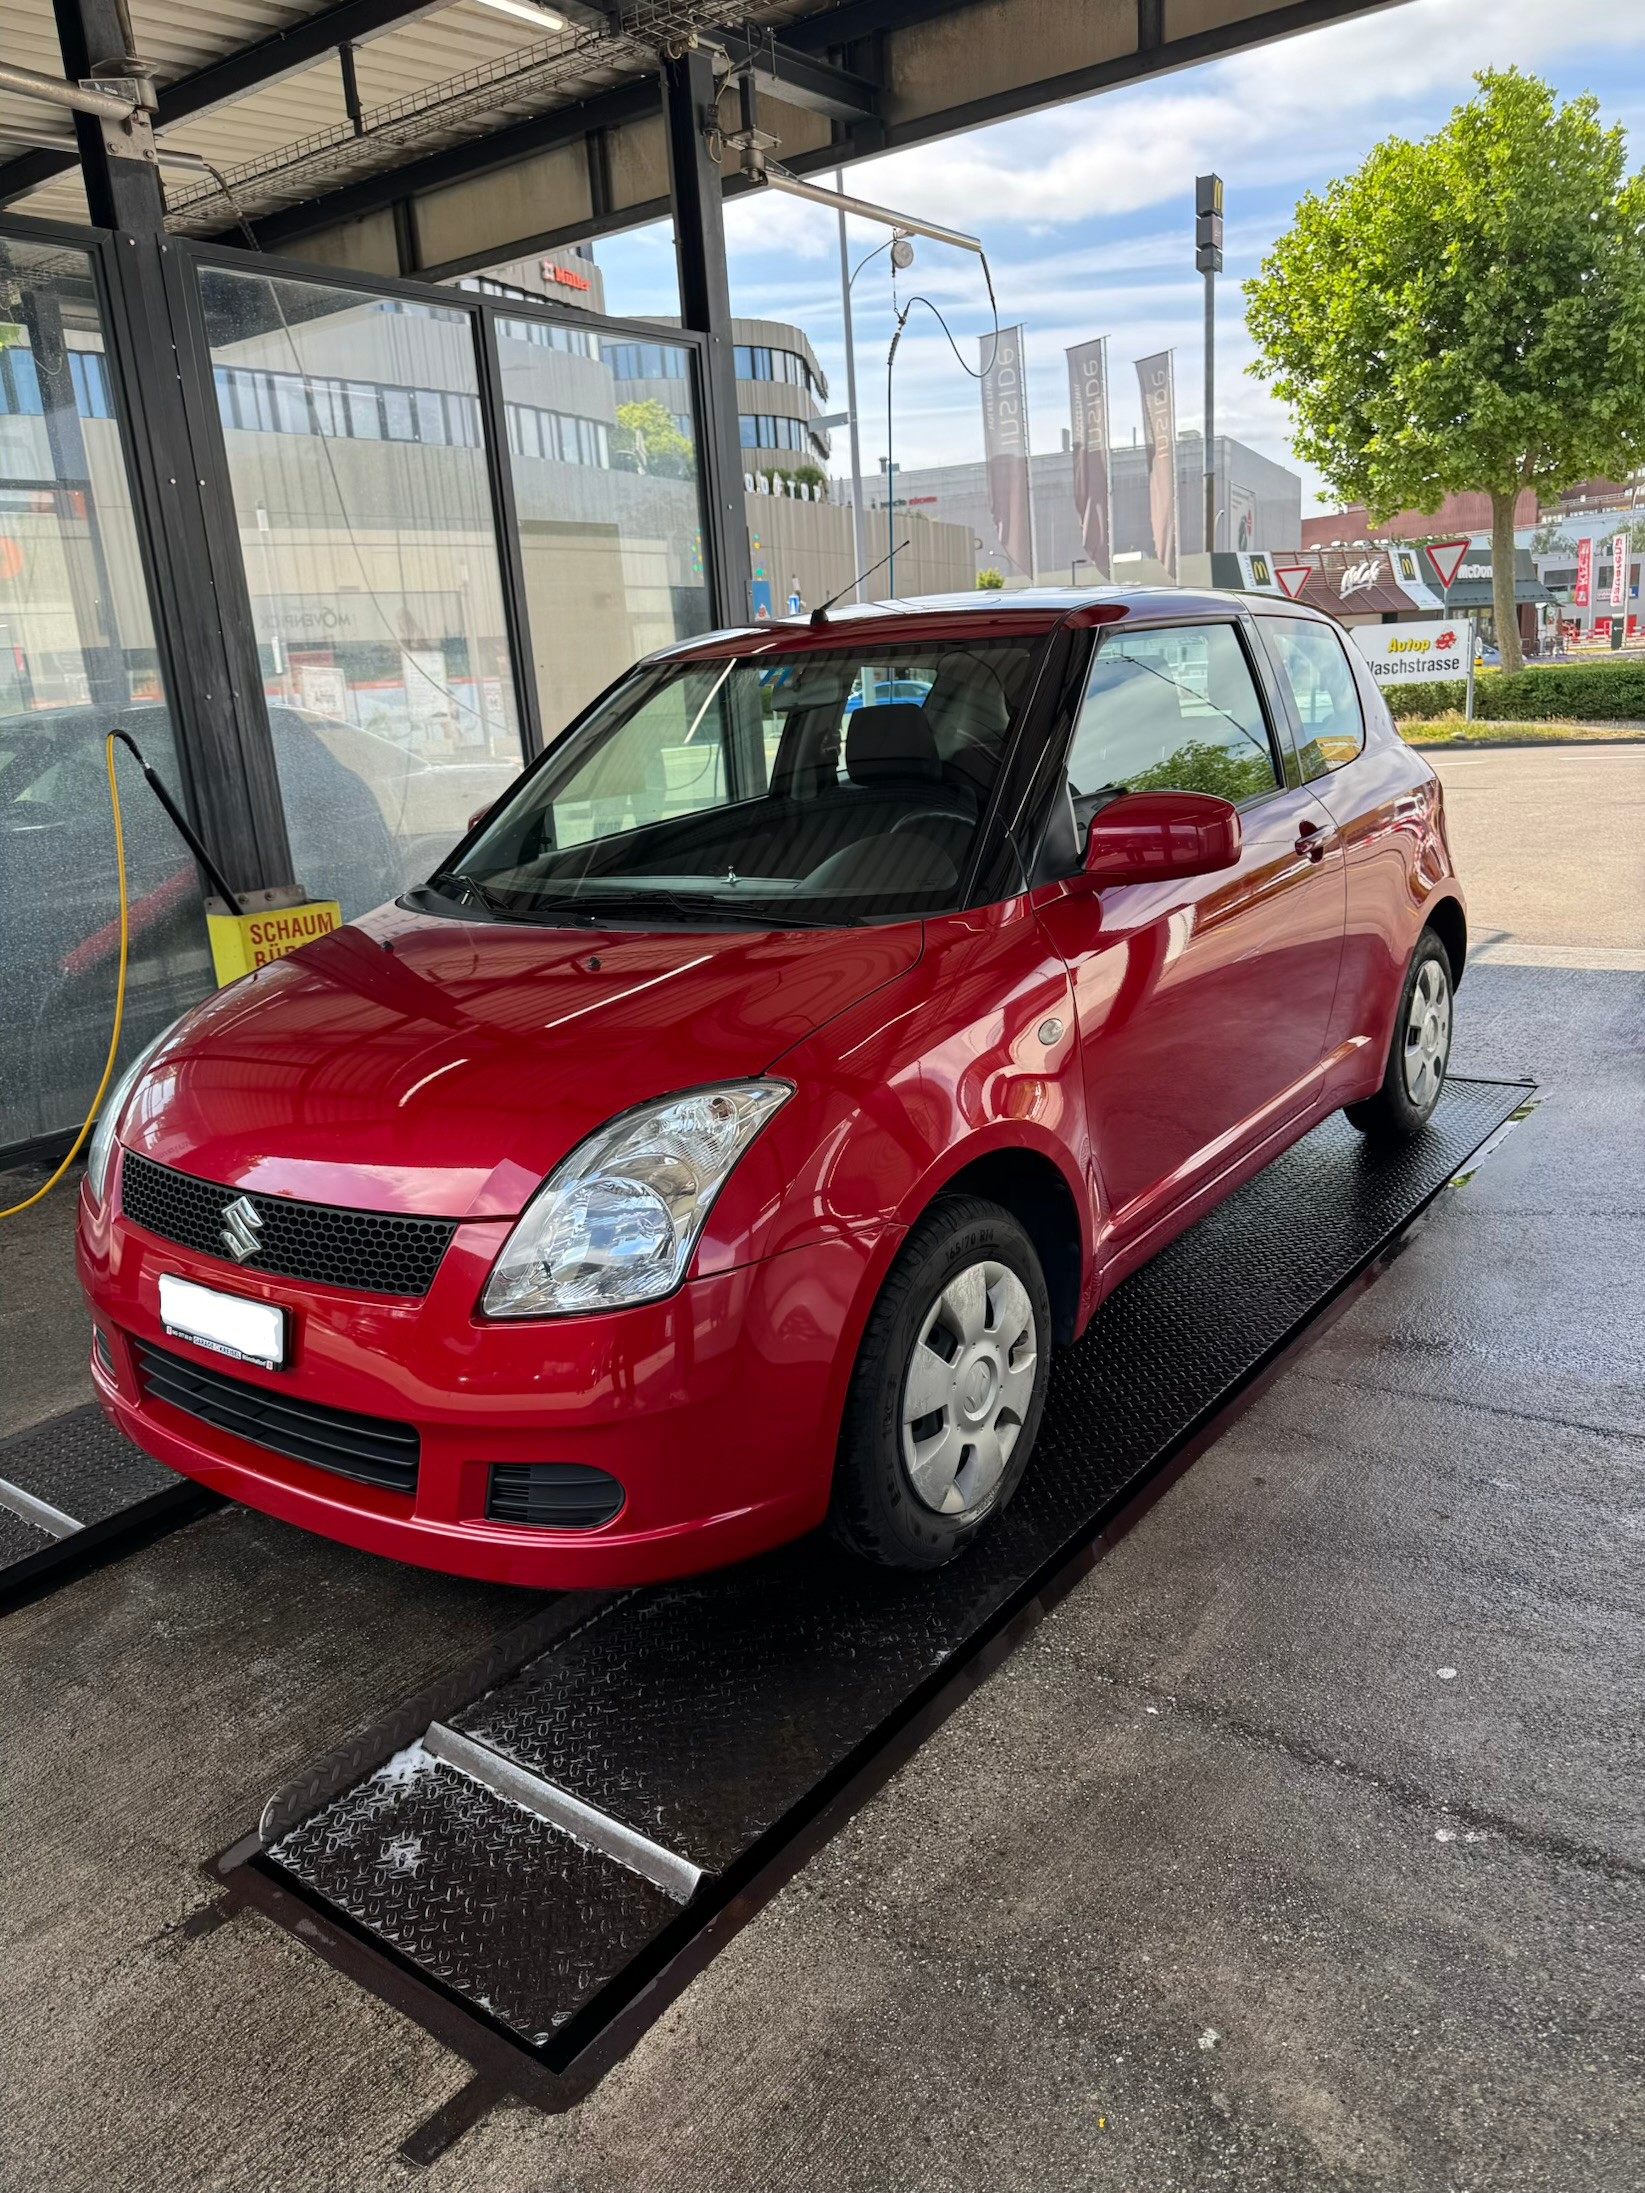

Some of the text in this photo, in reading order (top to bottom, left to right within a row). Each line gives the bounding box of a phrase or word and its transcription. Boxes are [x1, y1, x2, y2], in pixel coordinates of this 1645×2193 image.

[555, 266, 592, 292] Müller
[1387, 638, 1431, 653] Autop
[250, 912, 334, 945] SCHAUM
